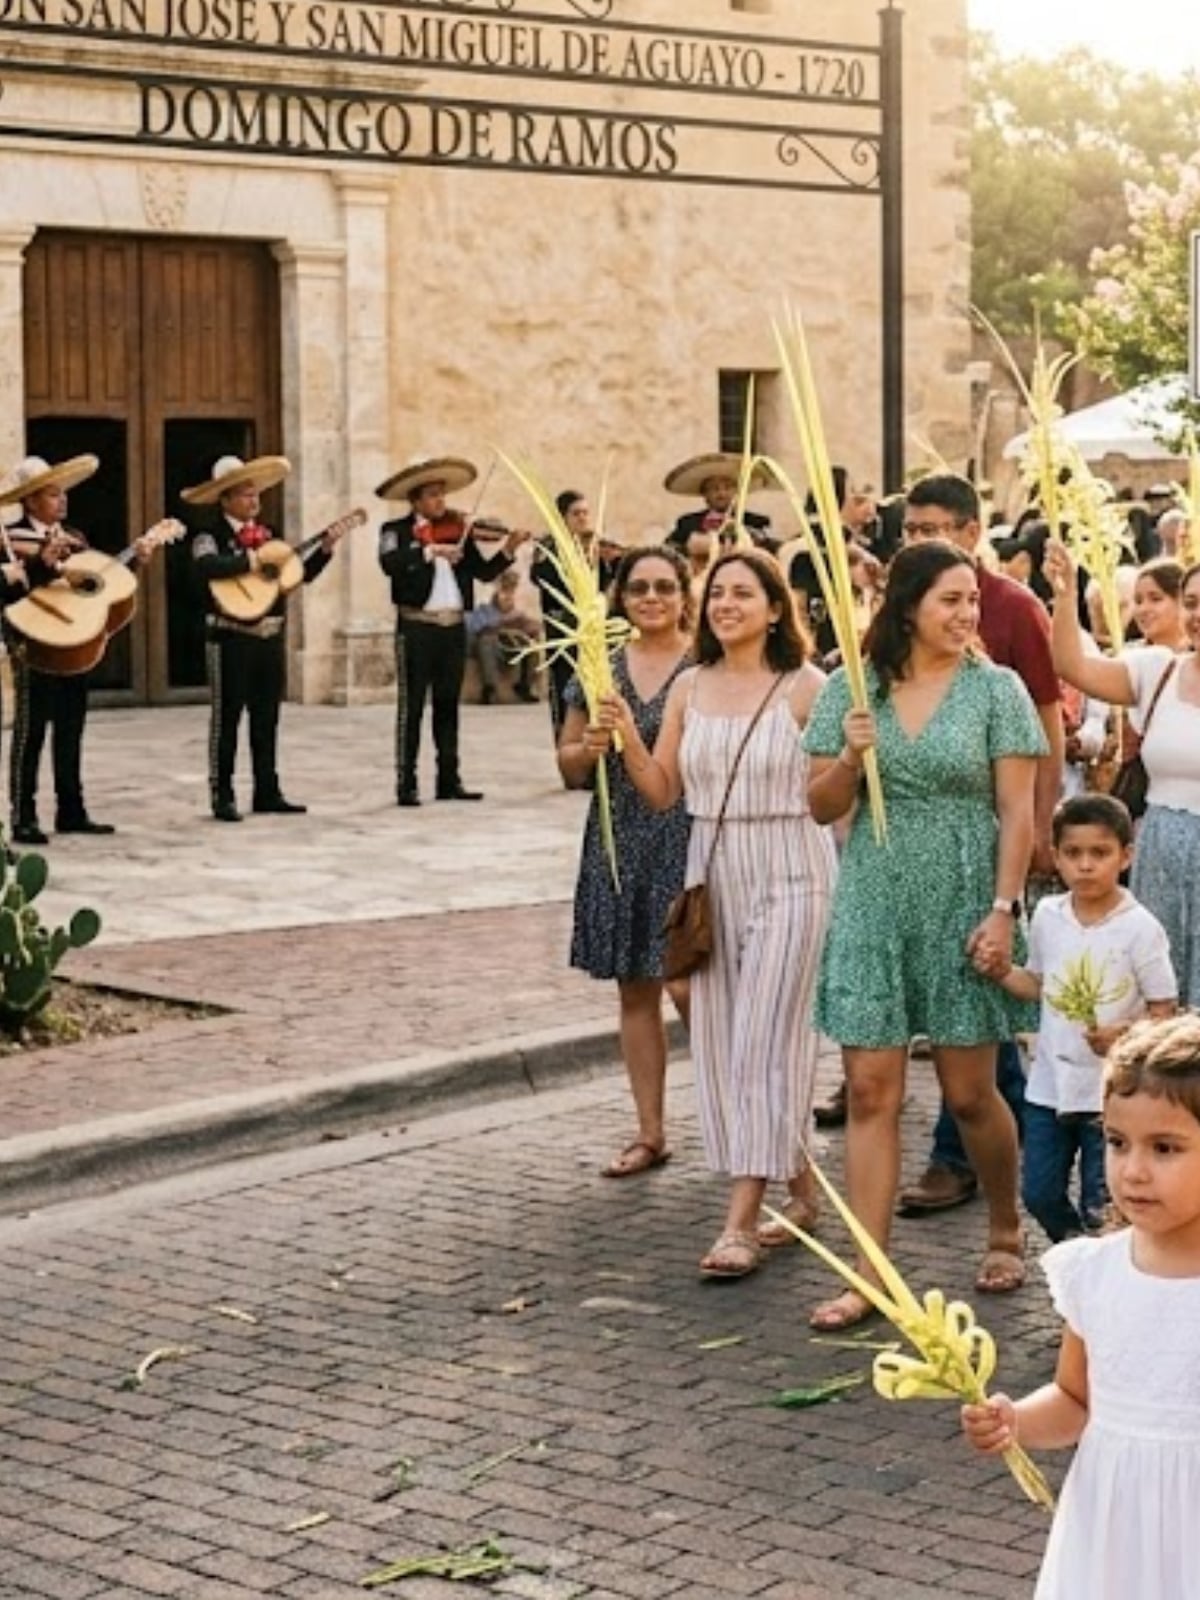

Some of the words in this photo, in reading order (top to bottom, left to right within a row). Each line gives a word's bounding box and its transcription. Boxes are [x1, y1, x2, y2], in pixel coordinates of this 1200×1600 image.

[62, 0, 147, 32] SAN
[267, 2, 295, 45] Y
[306, 5, 386, 53] SAN
[399, 14, 552, 70] MIGUEL
[561, 30, 612, 75] DE
[620, 36, 766, 91] AGUAYO
[797, 54, 866, 99] 1720
[136, 82, 412, 156] DOMINGO
[430, 105, 494, 160] DE
[508, 112, 678, 173] RAMOS
